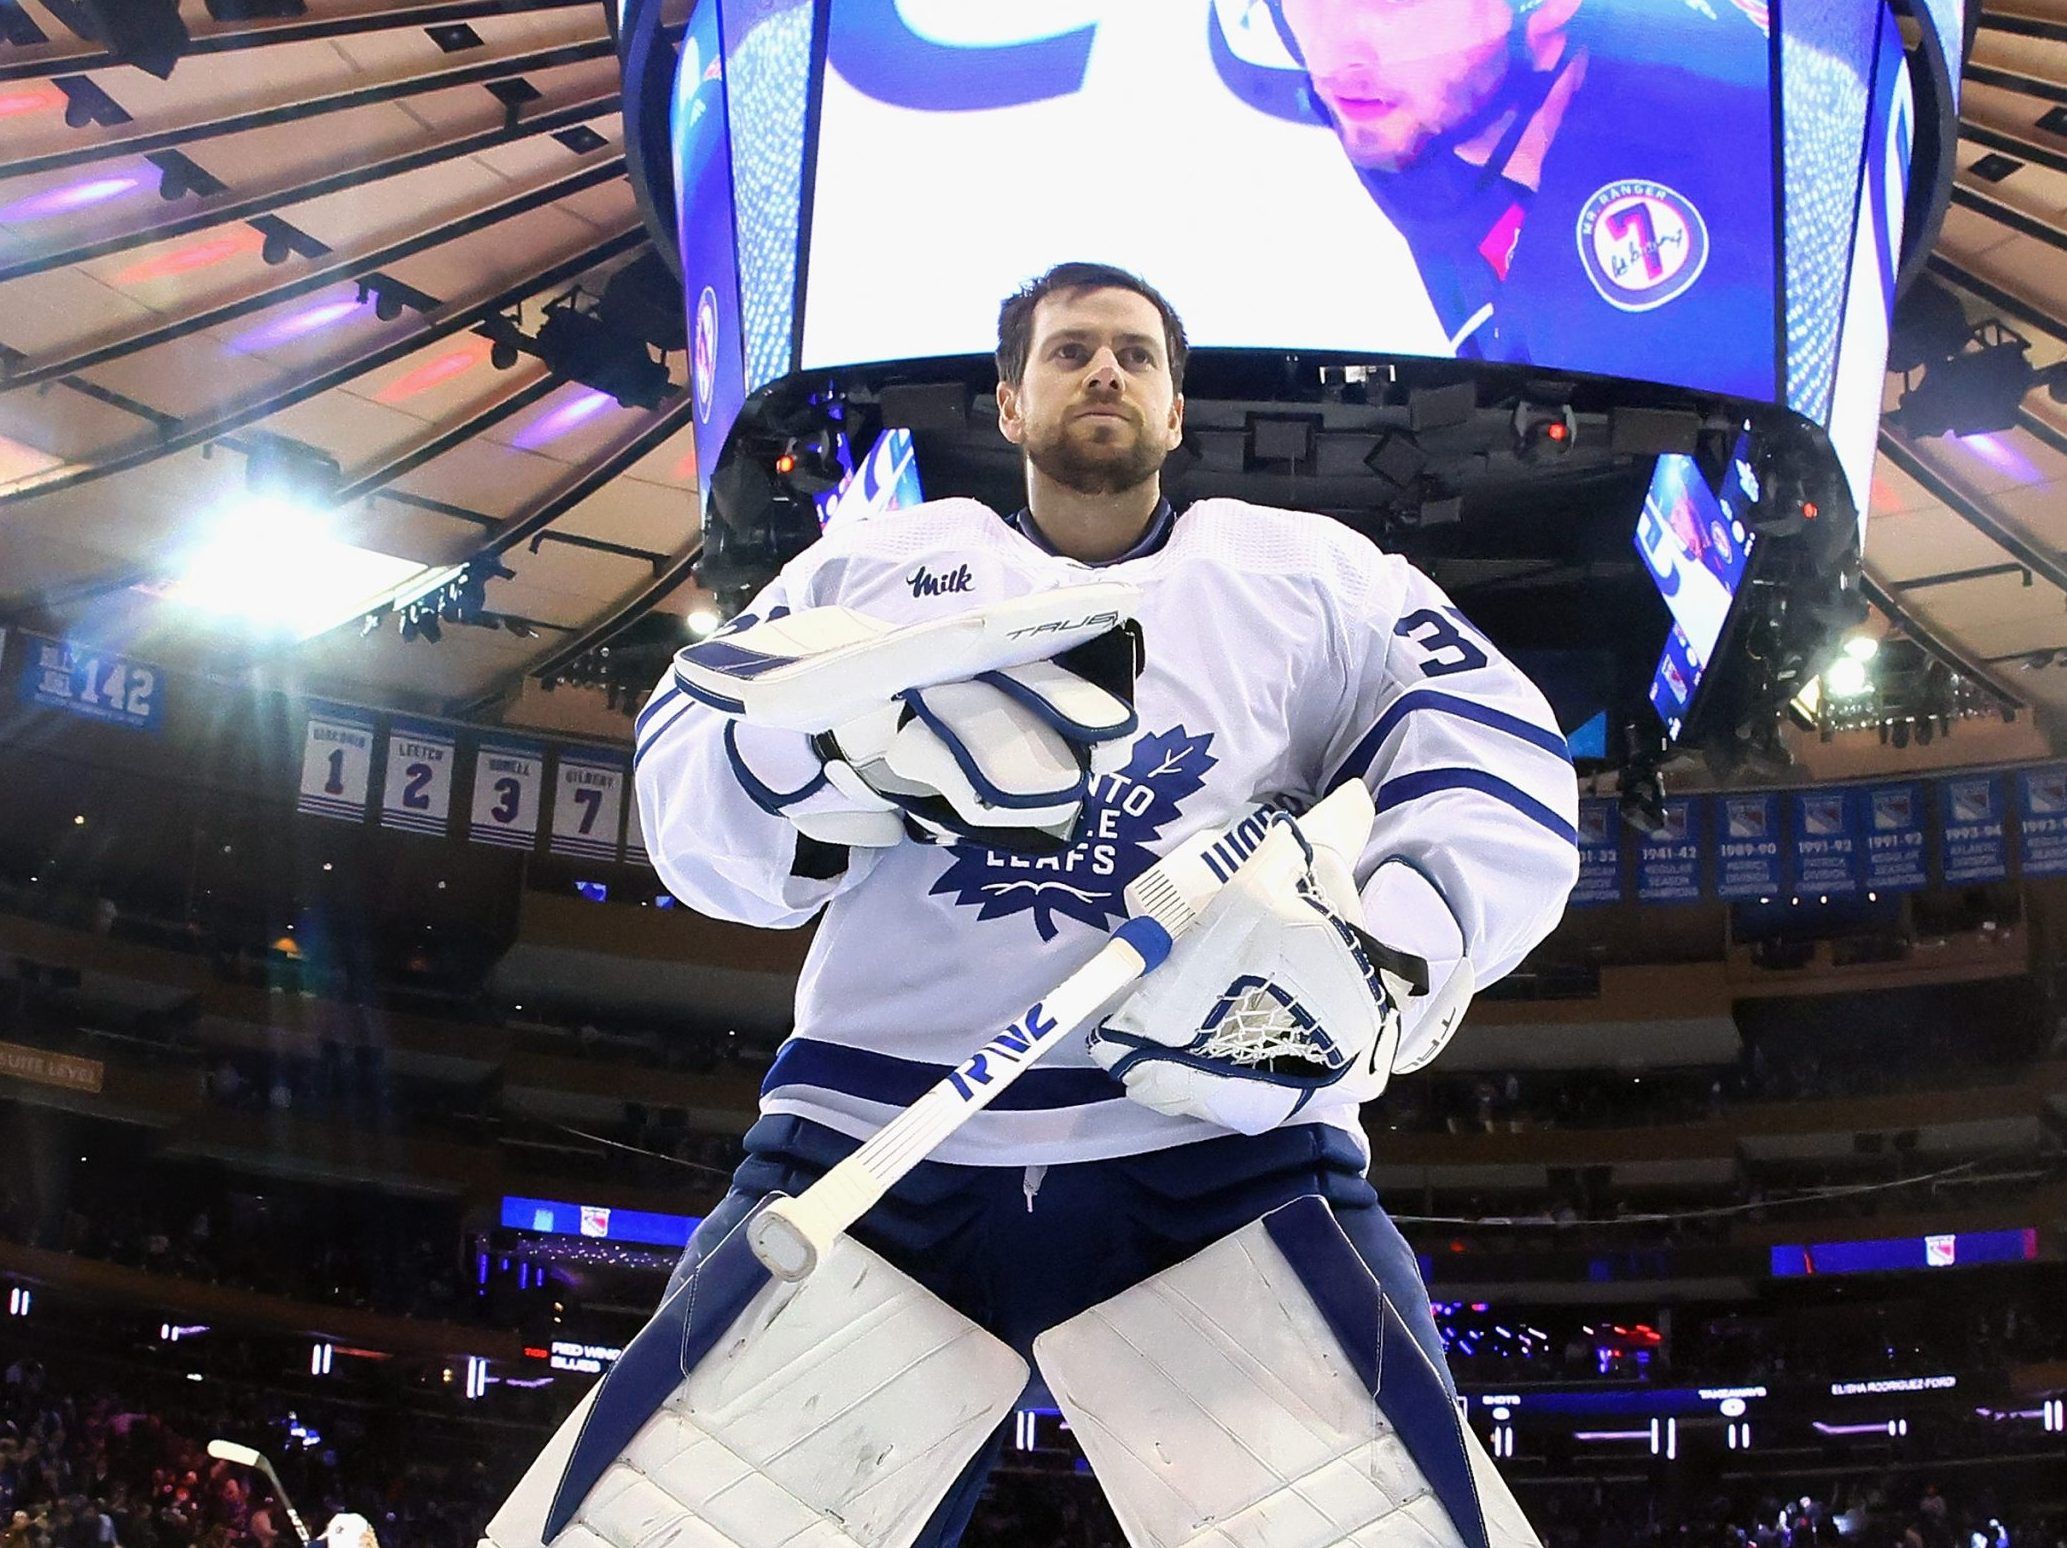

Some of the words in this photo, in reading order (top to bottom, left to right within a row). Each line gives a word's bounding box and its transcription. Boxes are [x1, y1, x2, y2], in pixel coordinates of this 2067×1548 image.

[1605, 202, 1663, 281] 7
[906, 563, 975, 598] Milk
[1006, 610, 1119, 641] TRUE
[1393, 605, 1491, 678] 3
[81, 658, 153, 716] 142
[324, 748, 344, 796] 1
[402, 762, 433, 810] 2
[490, 777, 522, 824] 3
[574, 788, 603, 835] 7
[552, 1341, 583, 1357] RED
